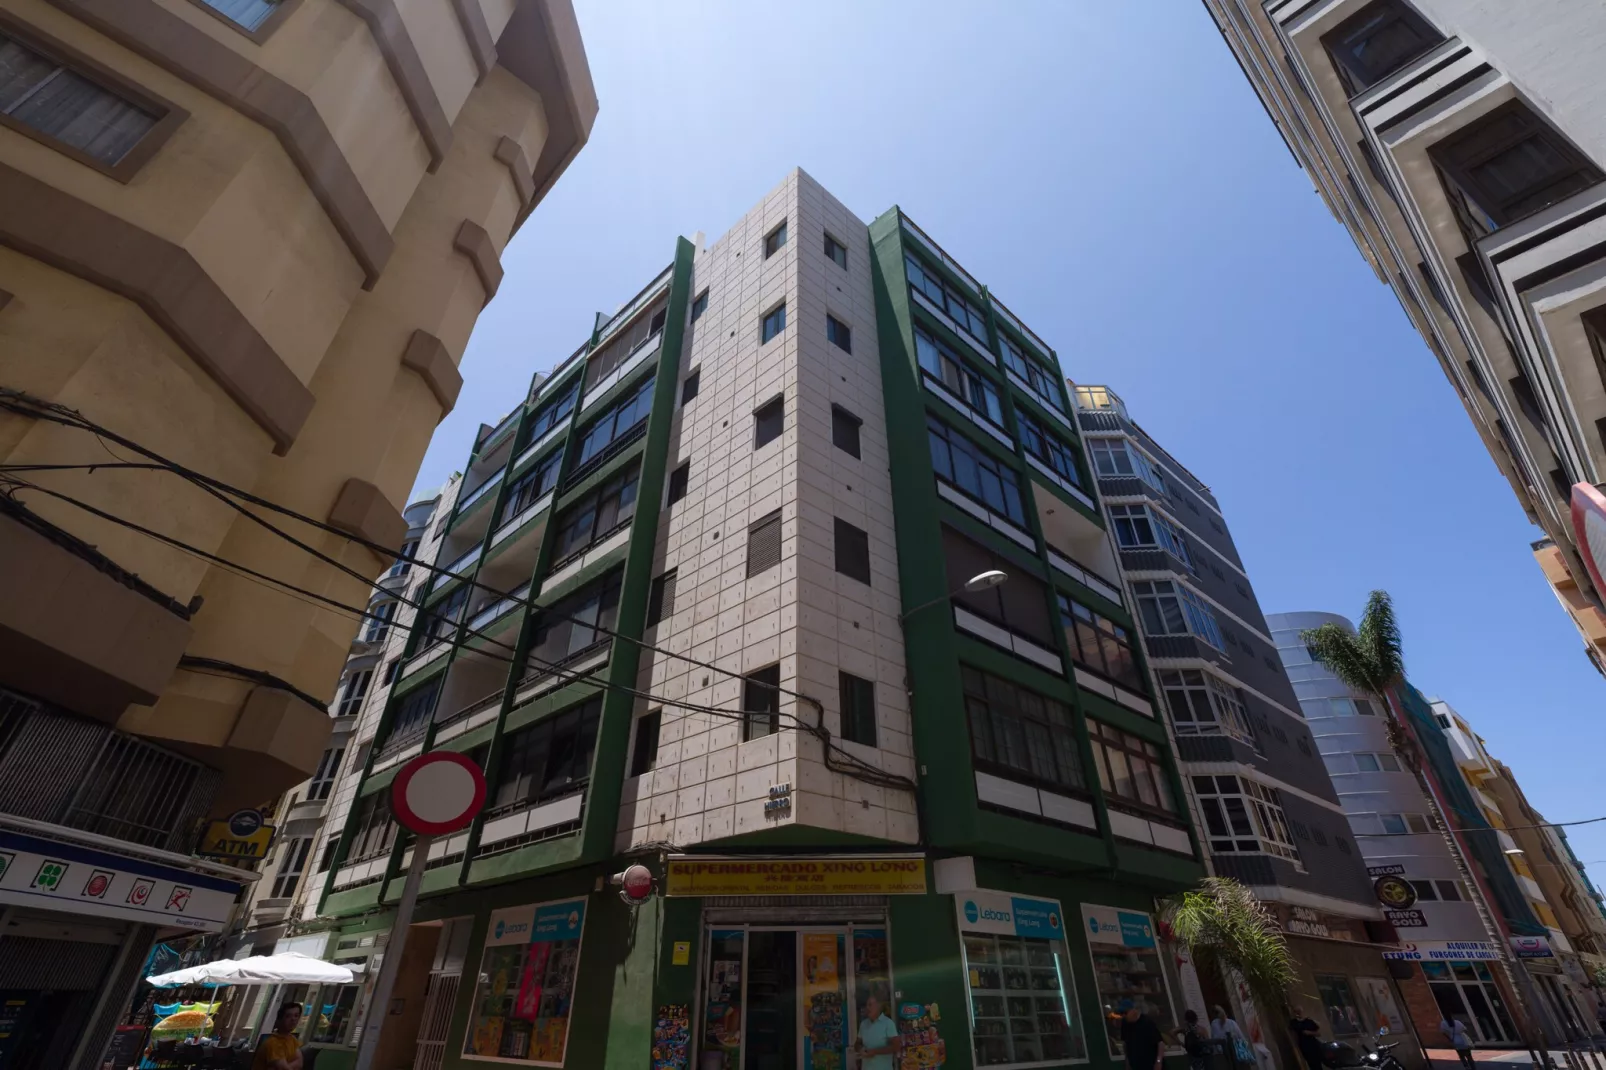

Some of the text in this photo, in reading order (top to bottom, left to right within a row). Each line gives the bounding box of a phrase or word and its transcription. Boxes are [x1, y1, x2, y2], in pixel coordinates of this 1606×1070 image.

[769, 783, 790, 796] CALLE
[211, 838, 260, 855] ATM
[672, 861, 919, 875] SUPERMERCADO XING LONG
[1368, 865, 1404, 875] SALON
[979, 906, 1011, 922] Lebara
[1391, 919, 1422, 927] GOLD
[1446, 942, 1480, 950] ALQUILER
[1429, 951, 1466, 959] FURGONES
[1466, 951, 1475, 959] DE
